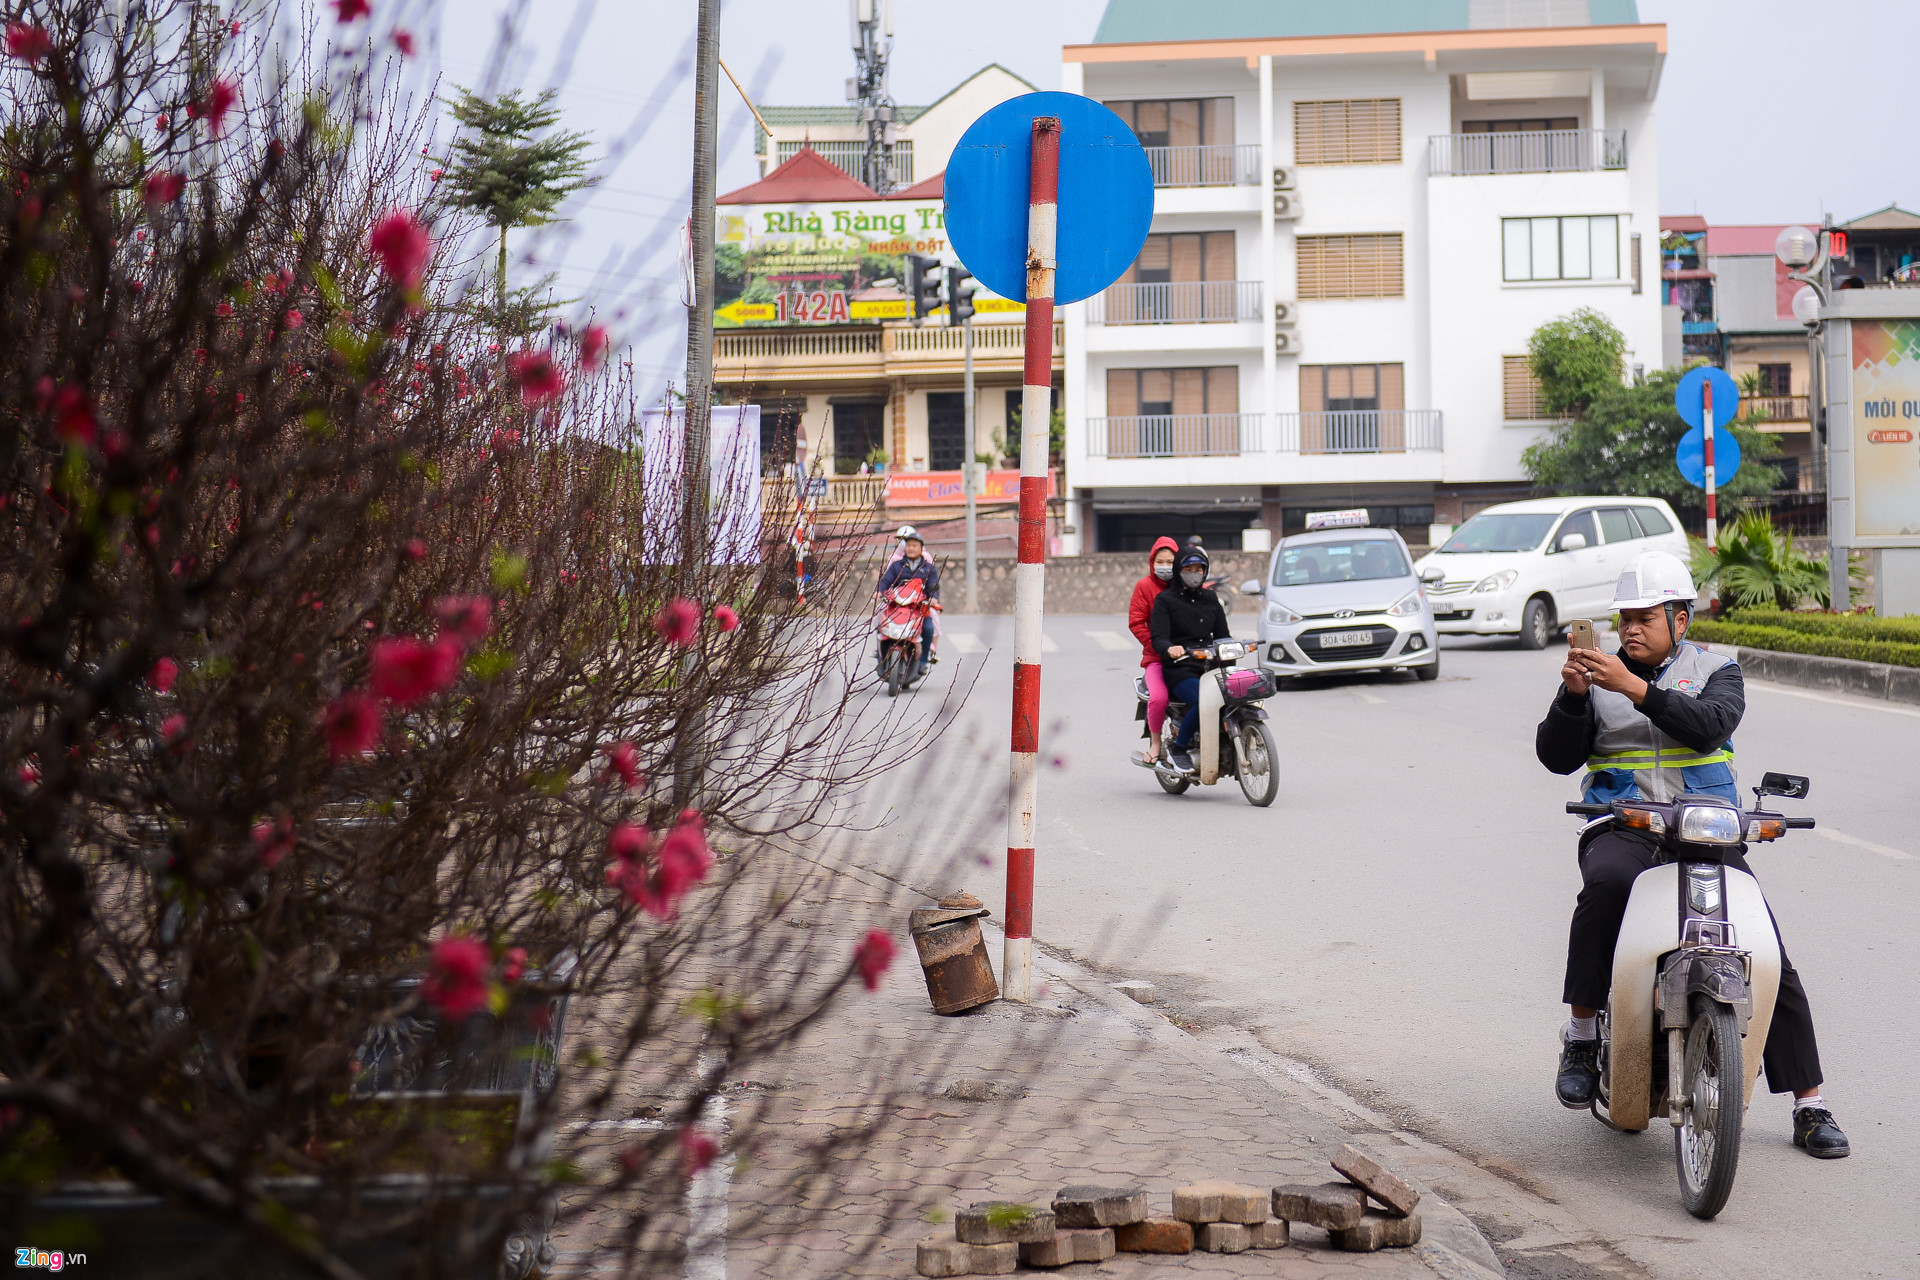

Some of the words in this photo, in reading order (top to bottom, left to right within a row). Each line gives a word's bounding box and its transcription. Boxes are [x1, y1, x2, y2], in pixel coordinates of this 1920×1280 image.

[763, 211, 823, 233] Nhà
[915, 237, 945, 255] ĐẶT
[776, 291, 849, 323] 142A
[1864, 397, 1896, 418] MỜI
